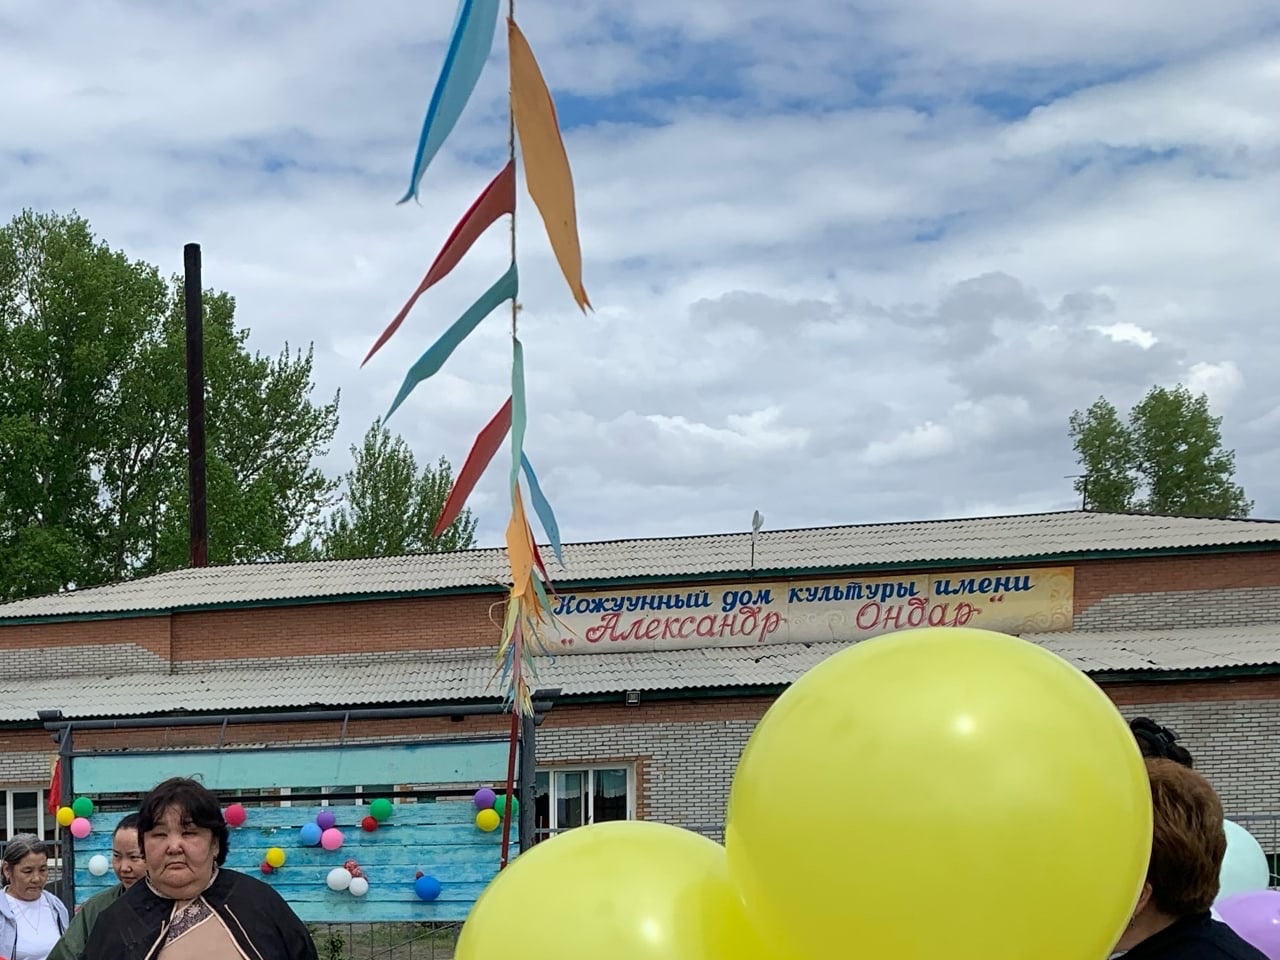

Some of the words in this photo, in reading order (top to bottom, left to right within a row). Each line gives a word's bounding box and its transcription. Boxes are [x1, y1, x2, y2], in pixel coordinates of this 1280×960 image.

[553, 588, 712, 616] Кожуунный
[721, 587, 774, 613] дом
[788, 579, 920, 604] культуры
[933, 574, 1035, 596] имени
